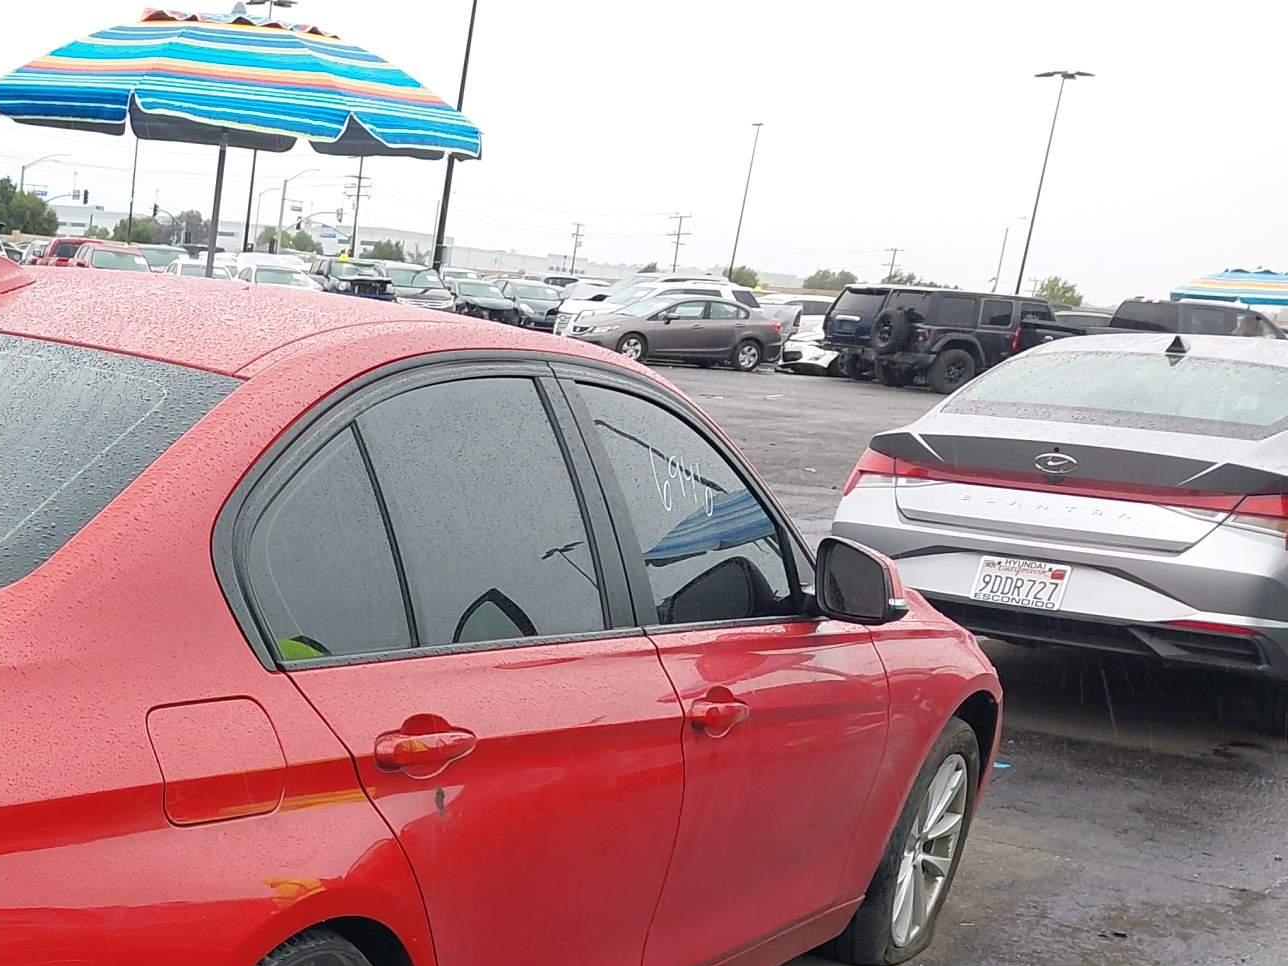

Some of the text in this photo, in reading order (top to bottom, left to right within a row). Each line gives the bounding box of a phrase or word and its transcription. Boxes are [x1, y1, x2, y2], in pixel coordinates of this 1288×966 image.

[961, 494, 1132, 520] ELANTRA
[1004, 559, 1047, 570] HYUNDAI
[979, 574, 1059, 602] 9DDR727
[974, 592, 1056, 609] ESCONDIDO
